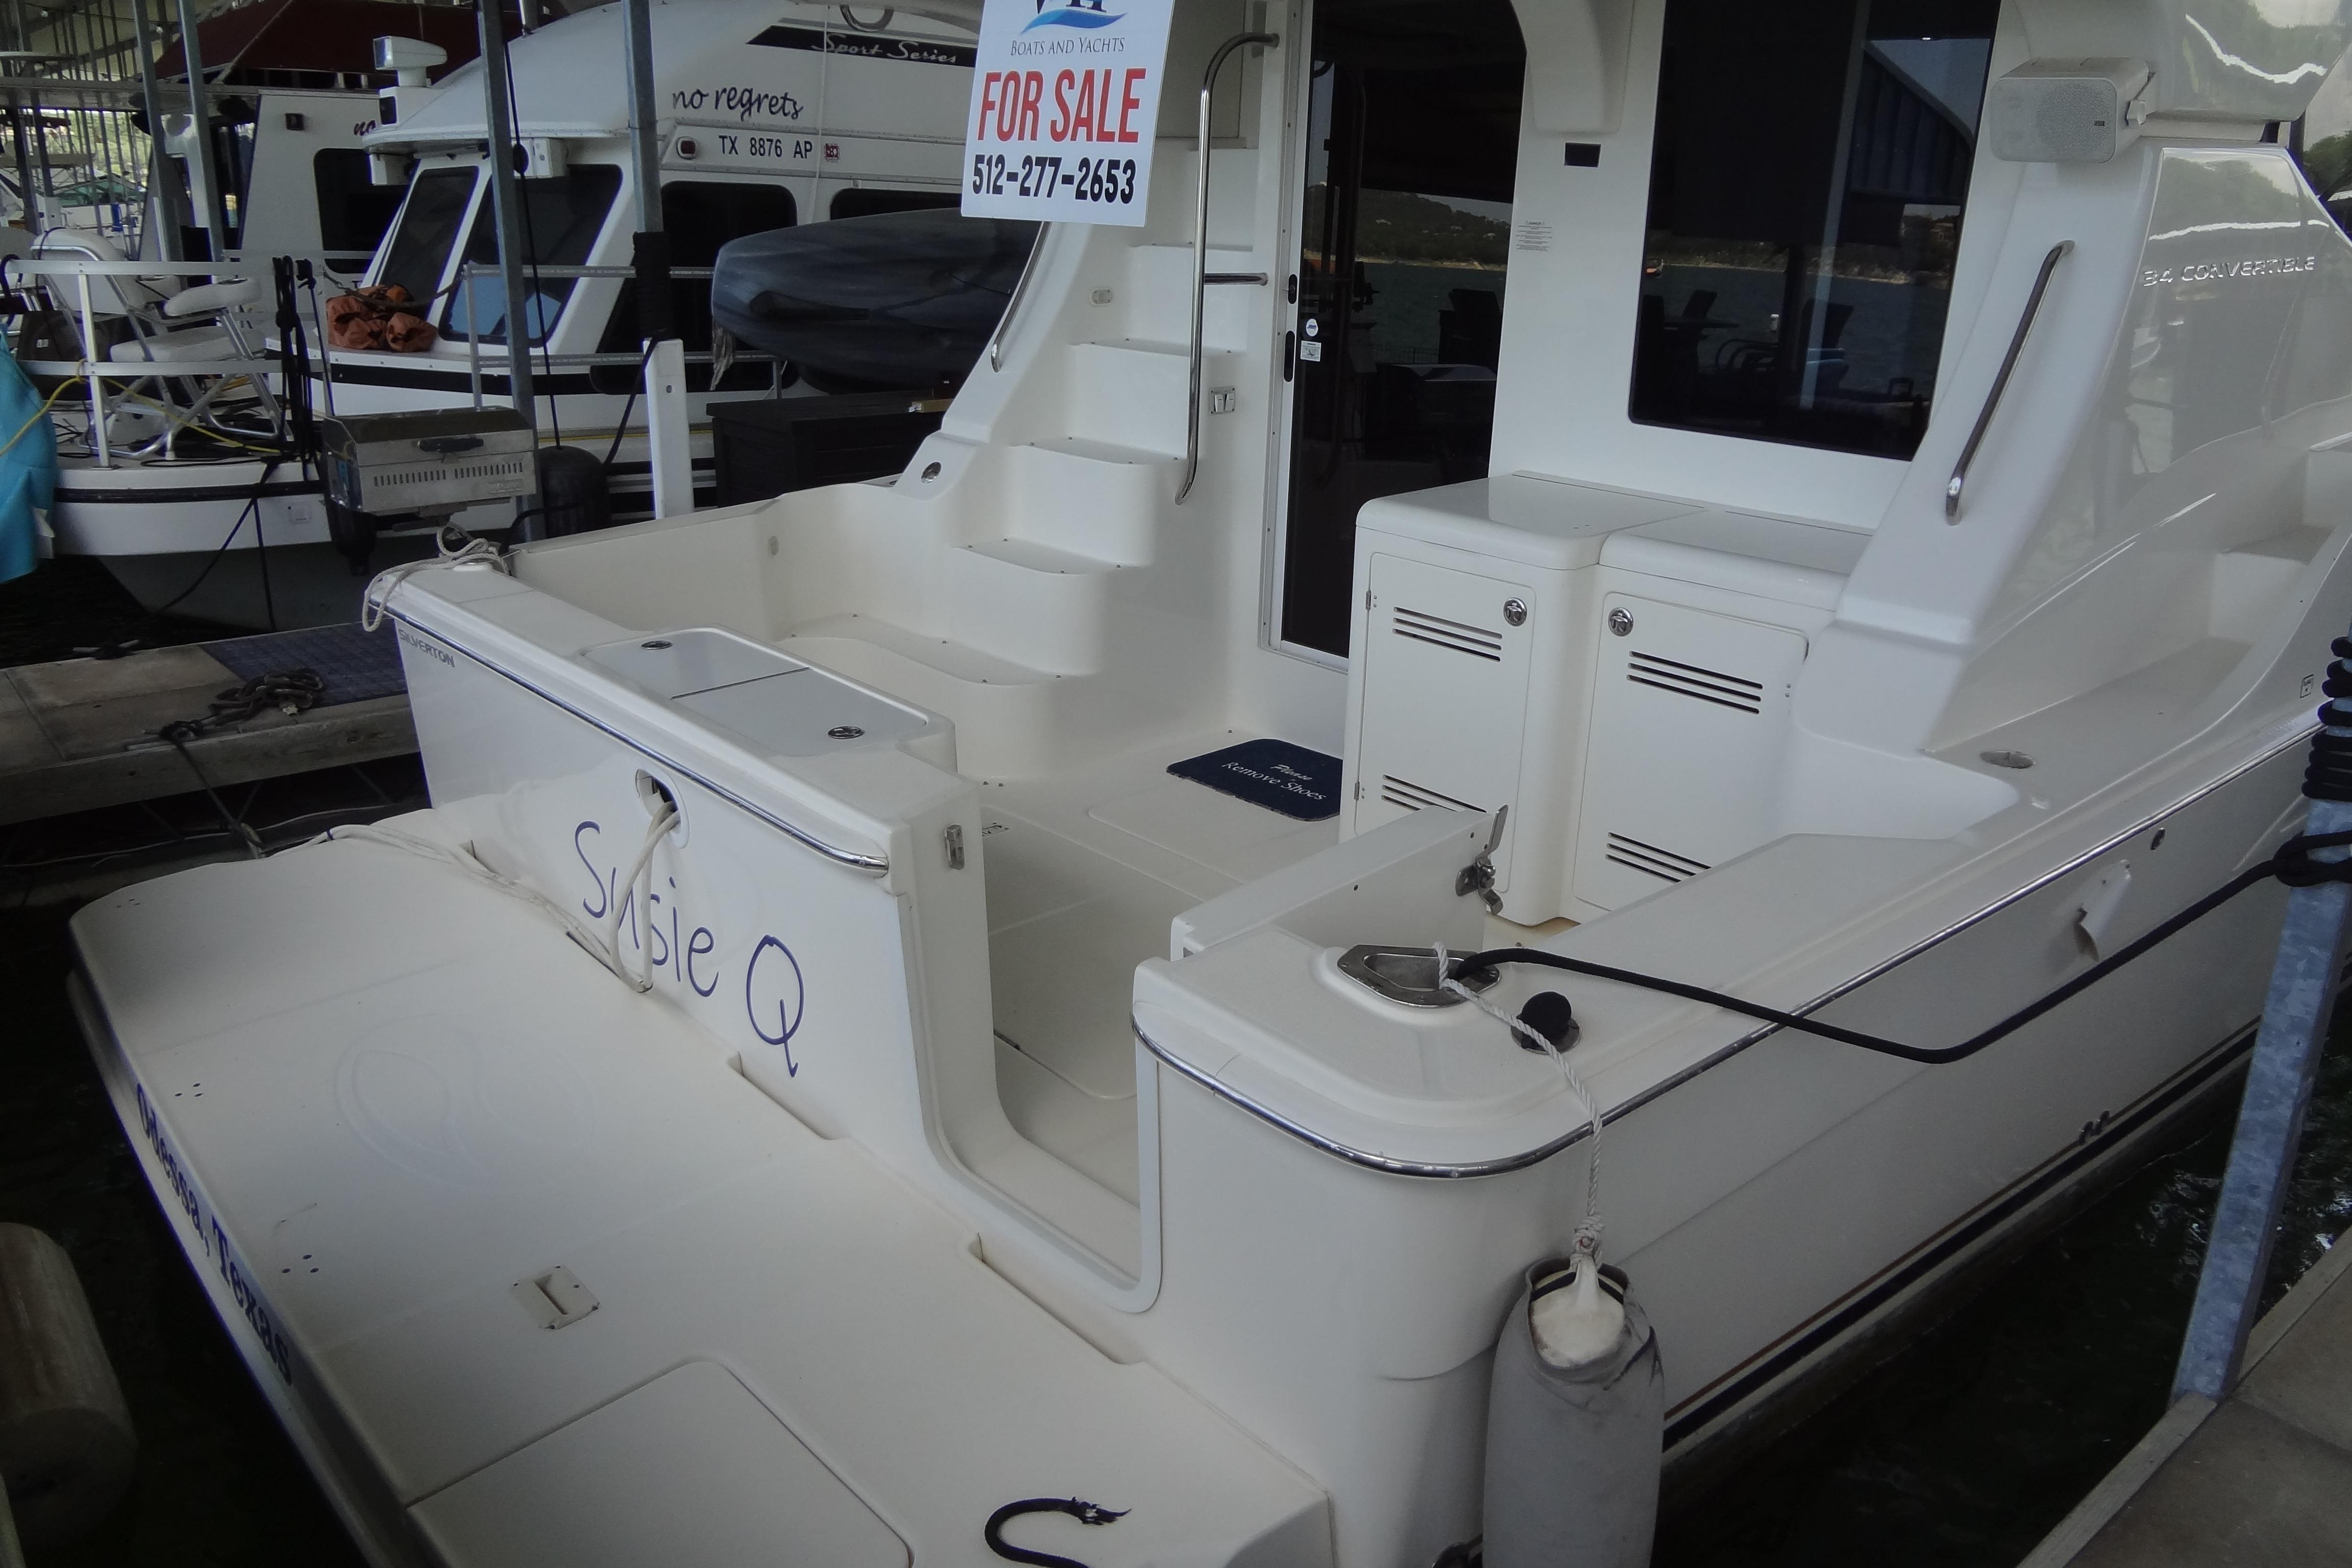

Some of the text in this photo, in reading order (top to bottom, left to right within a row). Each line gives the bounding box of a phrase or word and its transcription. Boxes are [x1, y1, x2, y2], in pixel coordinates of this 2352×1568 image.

[811, 33, 956, 63] Sport Series
[1010, 37, 1125, 55] BOATS AND YACHTS
[672, 86, 804, 122] no regrets
[977, 68, 1147, 143] FOR SALE
[719, 135, 739, 155] TX
[750, 137, 785, 158] 8876
[793, 140, 813, 159] AP
[972, 154, 1137, 204] 512-277-2653
[2143, 256, 2316, 287] 34 CONVERTIBLE
[398, 628, 455, 668] SILVERTON
[1222, 762, 1327, 800] Remove Shoes
[1270, 765, 1313, 781] Please
[746, 934, 805, 1078] Q
[211, 1213, 292, 1387] Texas
